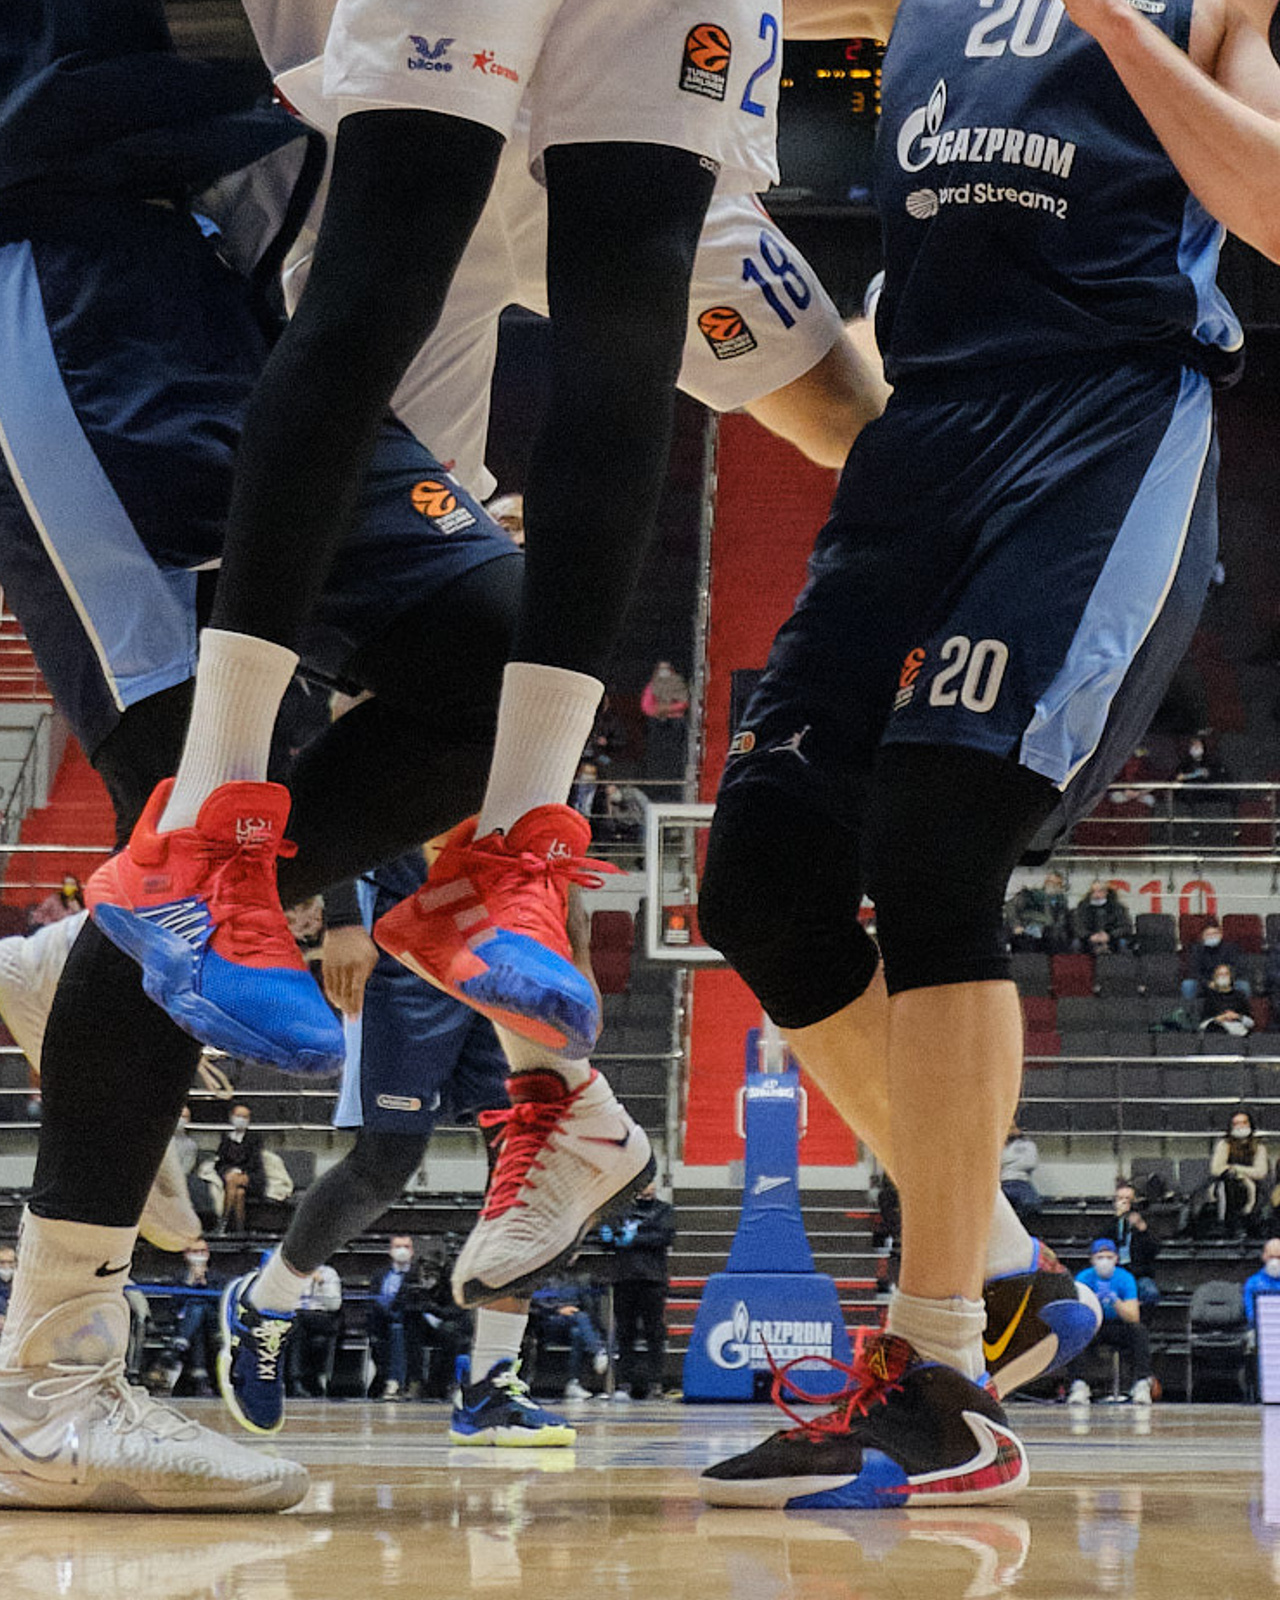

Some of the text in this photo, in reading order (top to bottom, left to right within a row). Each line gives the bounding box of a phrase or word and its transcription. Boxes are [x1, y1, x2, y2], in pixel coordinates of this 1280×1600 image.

[740, 12, 778, 118] 2
[936, 127, 1077, 179] GAZPROM
[742, 229, 811, 330] 18
[929, 635, 1009, 713] 20
[751, 1321, 832, 1344] GAZPROM
